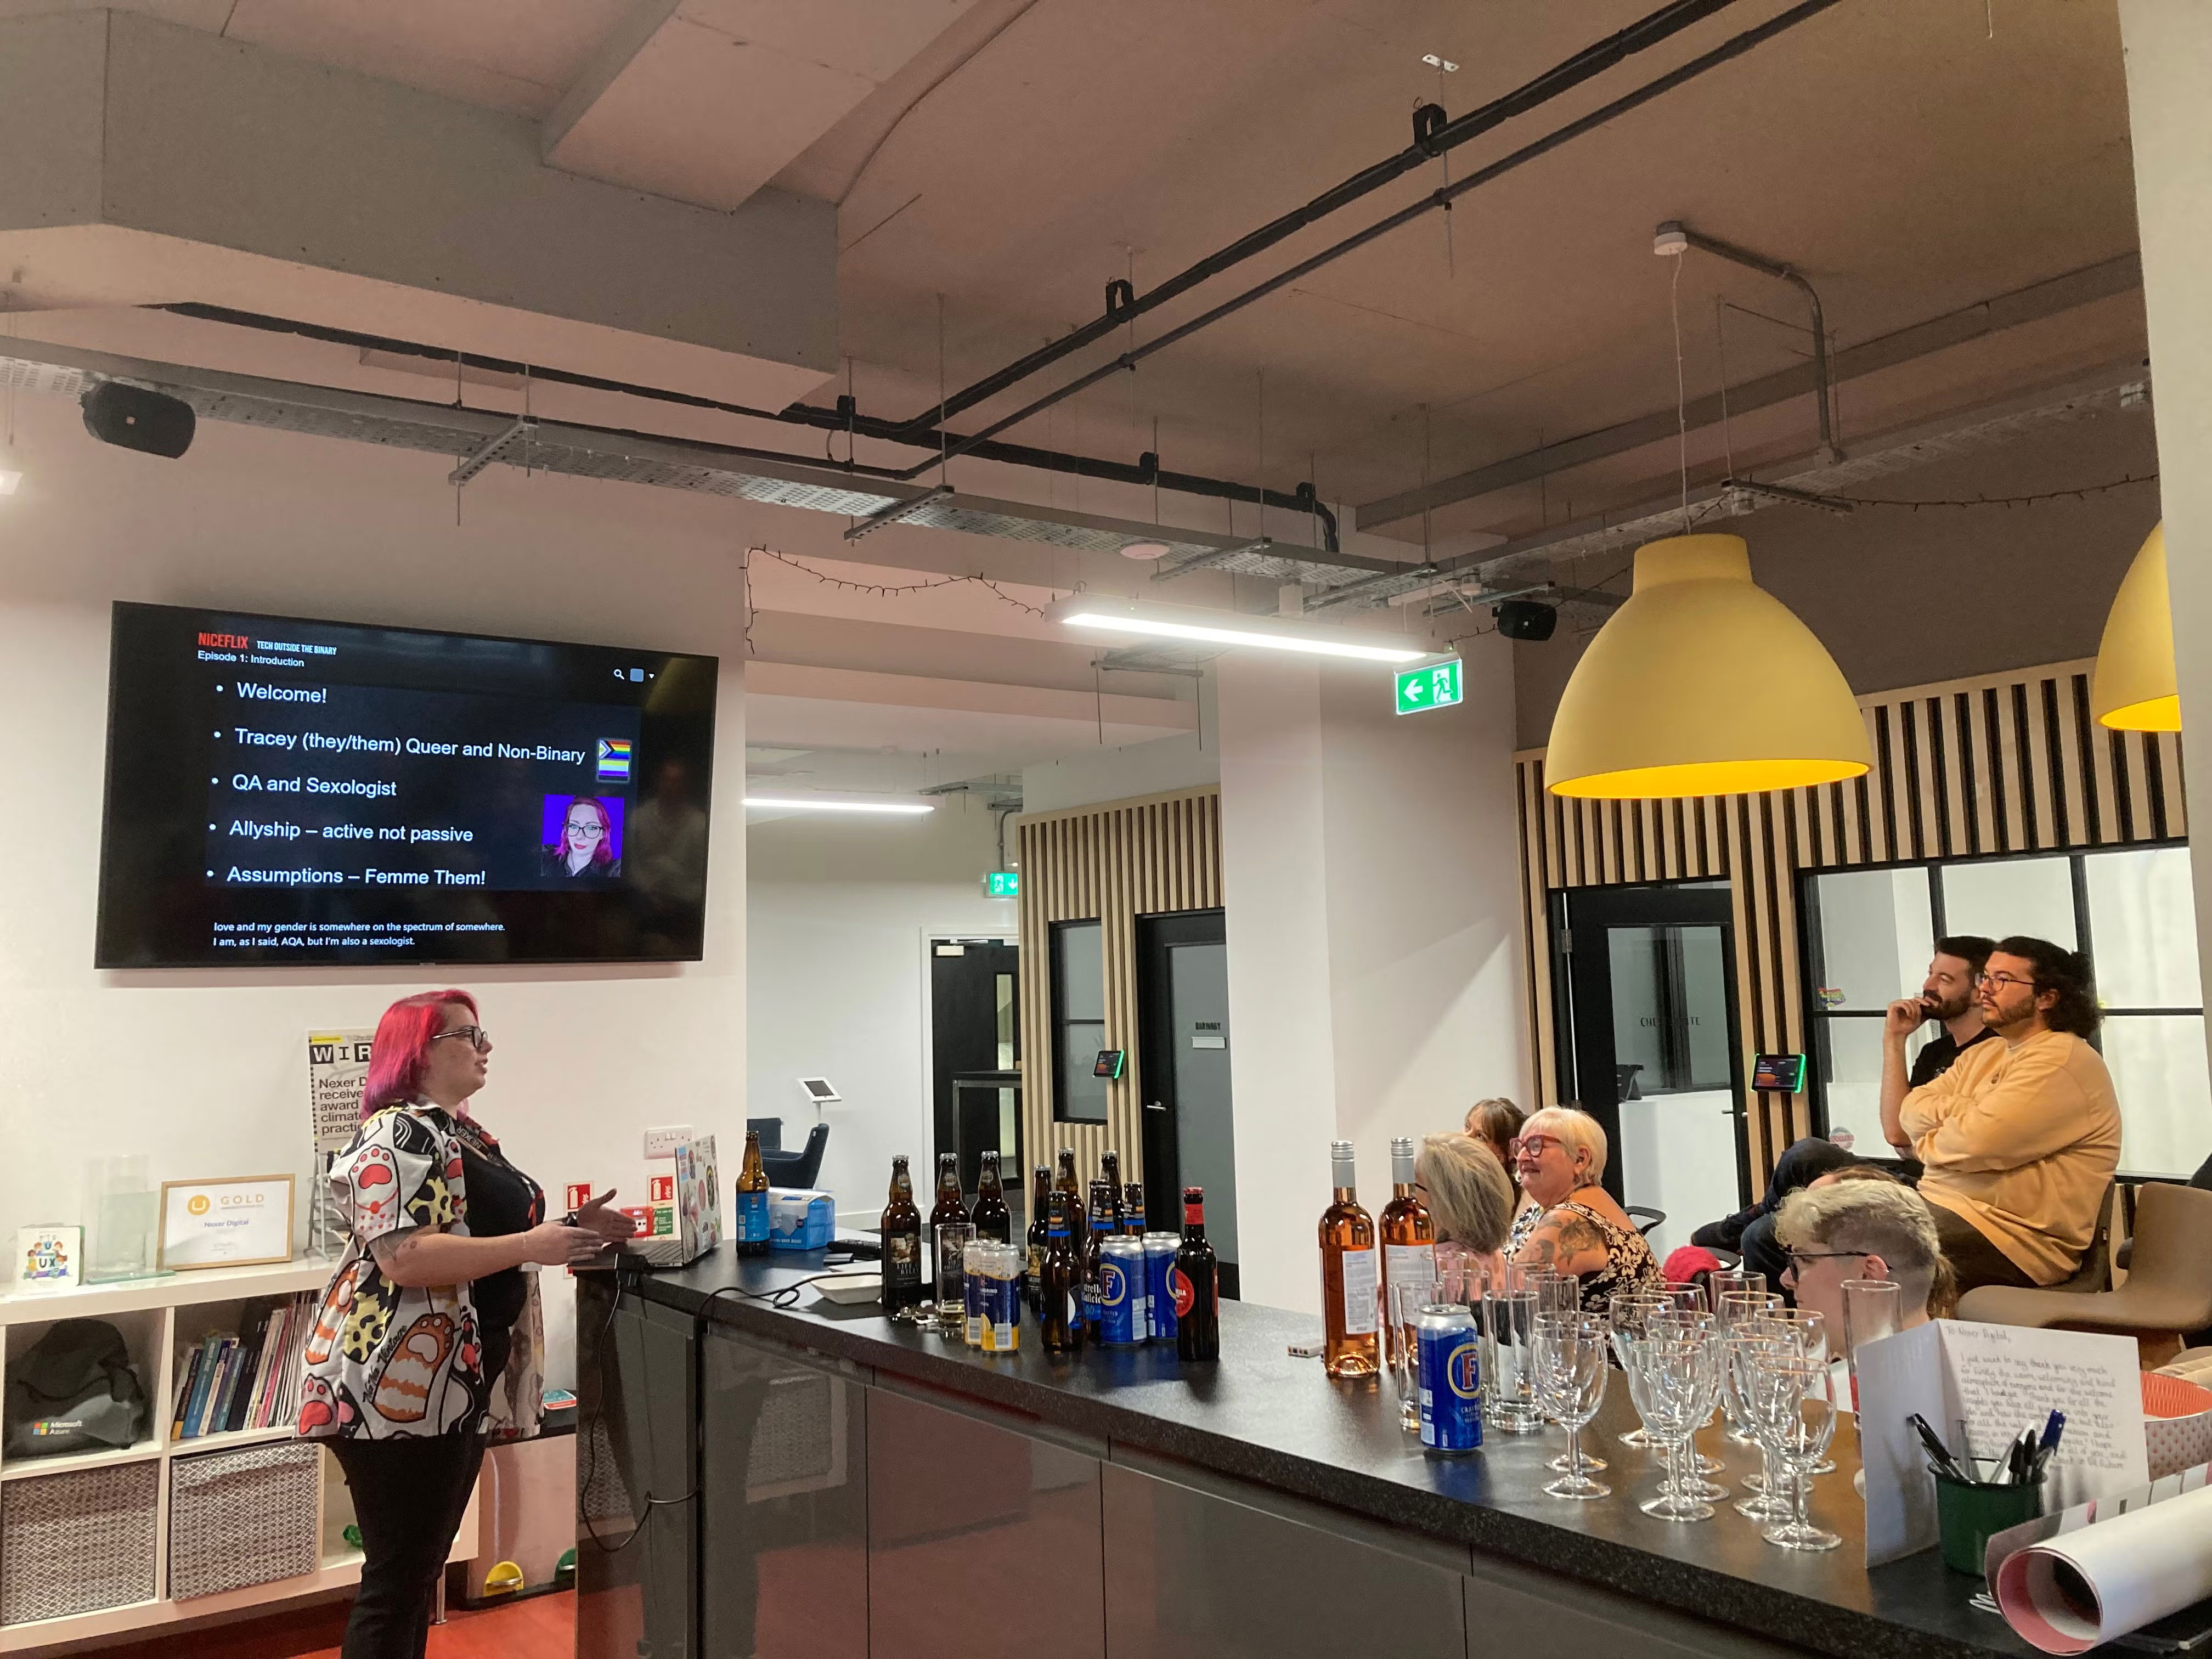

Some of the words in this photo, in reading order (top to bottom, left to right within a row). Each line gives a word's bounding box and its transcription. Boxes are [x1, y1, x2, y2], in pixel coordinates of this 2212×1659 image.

[198, 632, 248, 649] NICEFLIX
[256, 640, 274, 650] TECH
[273, 641, 301, 652] OUTSIDE
[300, 644, 314, 654] THE
[313, 645, 337, 656] BINARY
[198, 650, 238, 662] Episode
[239, 653, 249, 663] 1:
[251, 654, 304, 667] Introduction
[236, 681, 327, 703] Welcome!
[234, 727, 297, 751] Tracey
[302, 732, 401, 756] (they/them)
[405, 737, 459, 755] Queer
[462, 742, 493, 757] and
[498, 743, 586, 765] Non-Binary
[232, 774, 263, 791] QA
[266, 776, 301, 792] and
[306, 777, 397, 799] Sexologist
[229, 820, 301, 841] Allyship
[322, 823, 374, 839] active
[379, 826, 406, 840] not
[410, 826, 473, 844] passive
[227, 866, 343, 886] Assumptions
[365, 868, 430, 884] Femme
[433, 870, 486, 885] Them!
[214, 922, 235, 932] love
[236, 922, 255, 932] and
[257, 924, 273, 933] my
[274, 922, 308, 933] gender
[309, 922, 317, 931] is
[319, 922, 371, 931] somewhere
[386, 922, 402, 931] the
[403, 923, 443, 933] spectrum
[444, 922, 455, 931] of
[455, 922, 505, 931] somewhere.
[213, 937, 217, 946] I
[219, 939, 237, 947] am,
[252, 937, 256, 946] I
[257, 936, 279, 947] said,
[281, 936, 305, 947] AQA,
[307, 936, 324, 946] but
[325, 936, 340, 945] I'm
[341, 936, 360, 946] also
[369, 936, 415, 947] sexologist.
[309, 1042, 373, 1064] WIR
[319, 1078, 356, 1089] Nexer
[320, 1088, 364, 1100] receive
[320, 1099, 359, 1111] award
[456, 1125, 482, 1149] NEXER
[221, 1194, 264, 1205] GOLD
[226, 1219, 249, 1227] Digital
